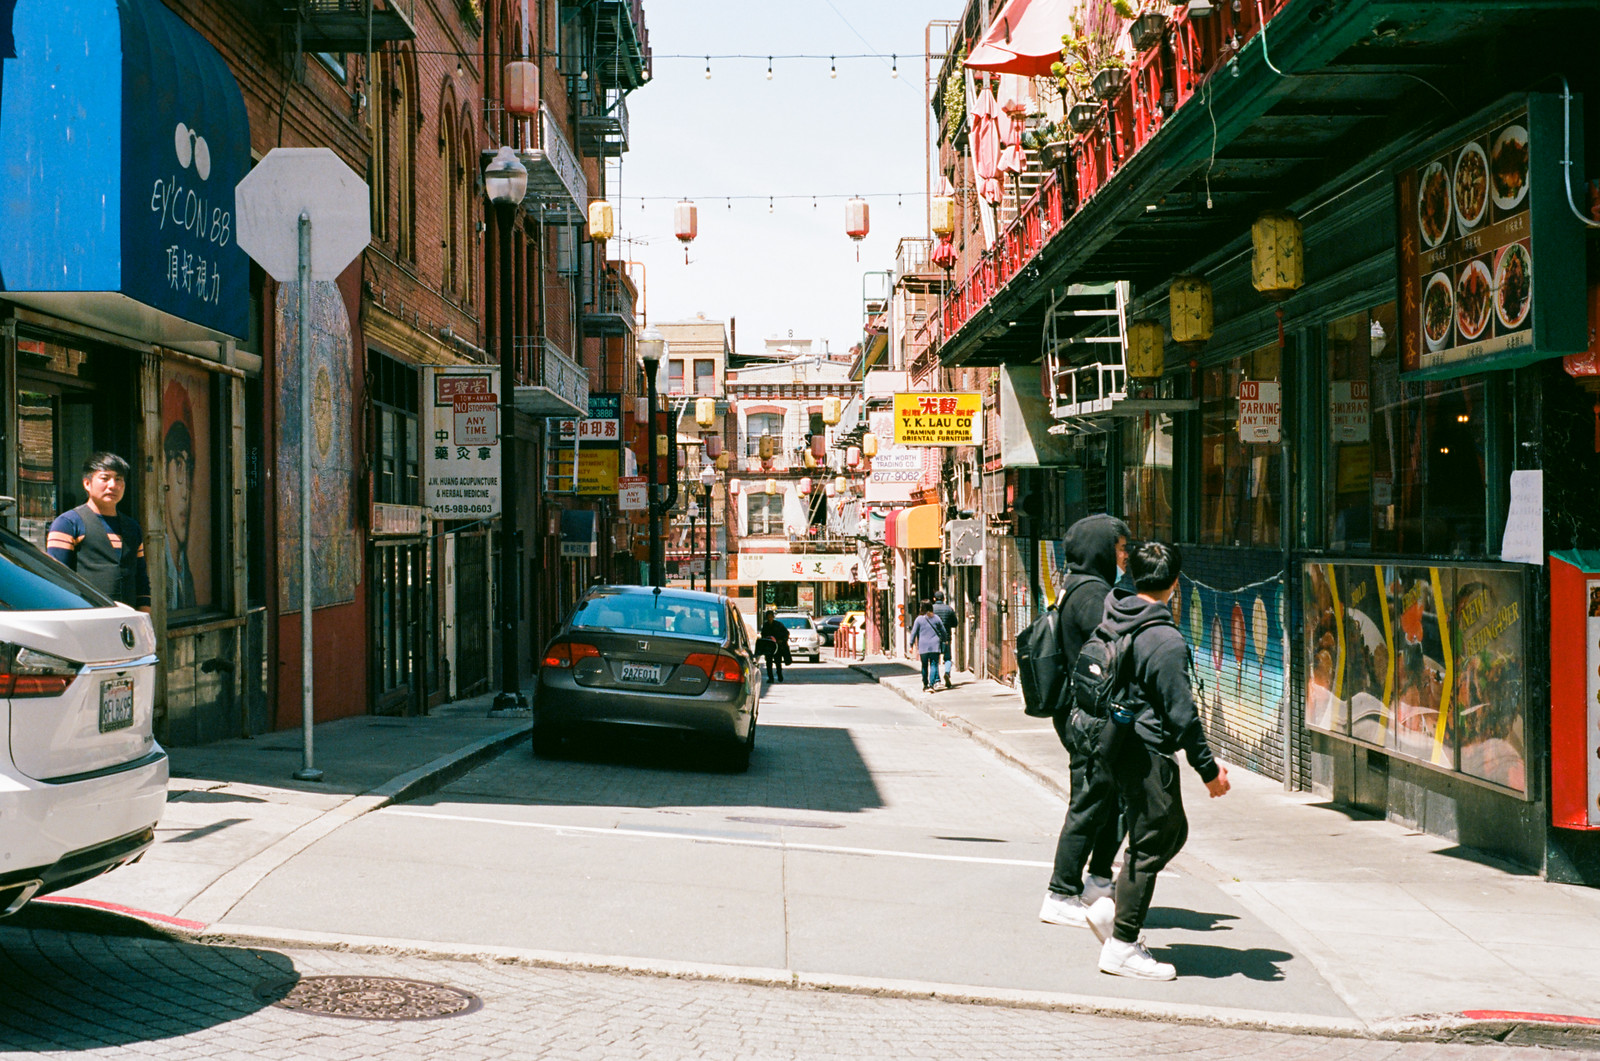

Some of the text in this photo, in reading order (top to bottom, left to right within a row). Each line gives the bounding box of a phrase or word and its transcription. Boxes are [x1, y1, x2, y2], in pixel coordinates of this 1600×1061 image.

[210, 207, 231, 247] 88
[166, 244, 220, 305] 頂好視力
[1241, 384, 1256, 398] NO
[455, 402, 496, 412] NO STOPPING
[1241, 403, 1279, 414] PARKING
[466, 416, 485, 425] ANY
[903, 418, 911, 427] Y.
[915, 418, 925, 427] K.
[929, 418, 951, 427] LAU
[1242, 416, 1277, 425] ANY TIME
[465, 426, 487, 434] TIME
[873, 472, 919, 481] 677-9062
[440, 477, 458, 486] HUANG
[460, 477, 497, 486] ACUPUNCTURE
[436, 489, 489, 498] & HERBAL MEDICINE
[434, 504, 492, 513] 415-989-0603
